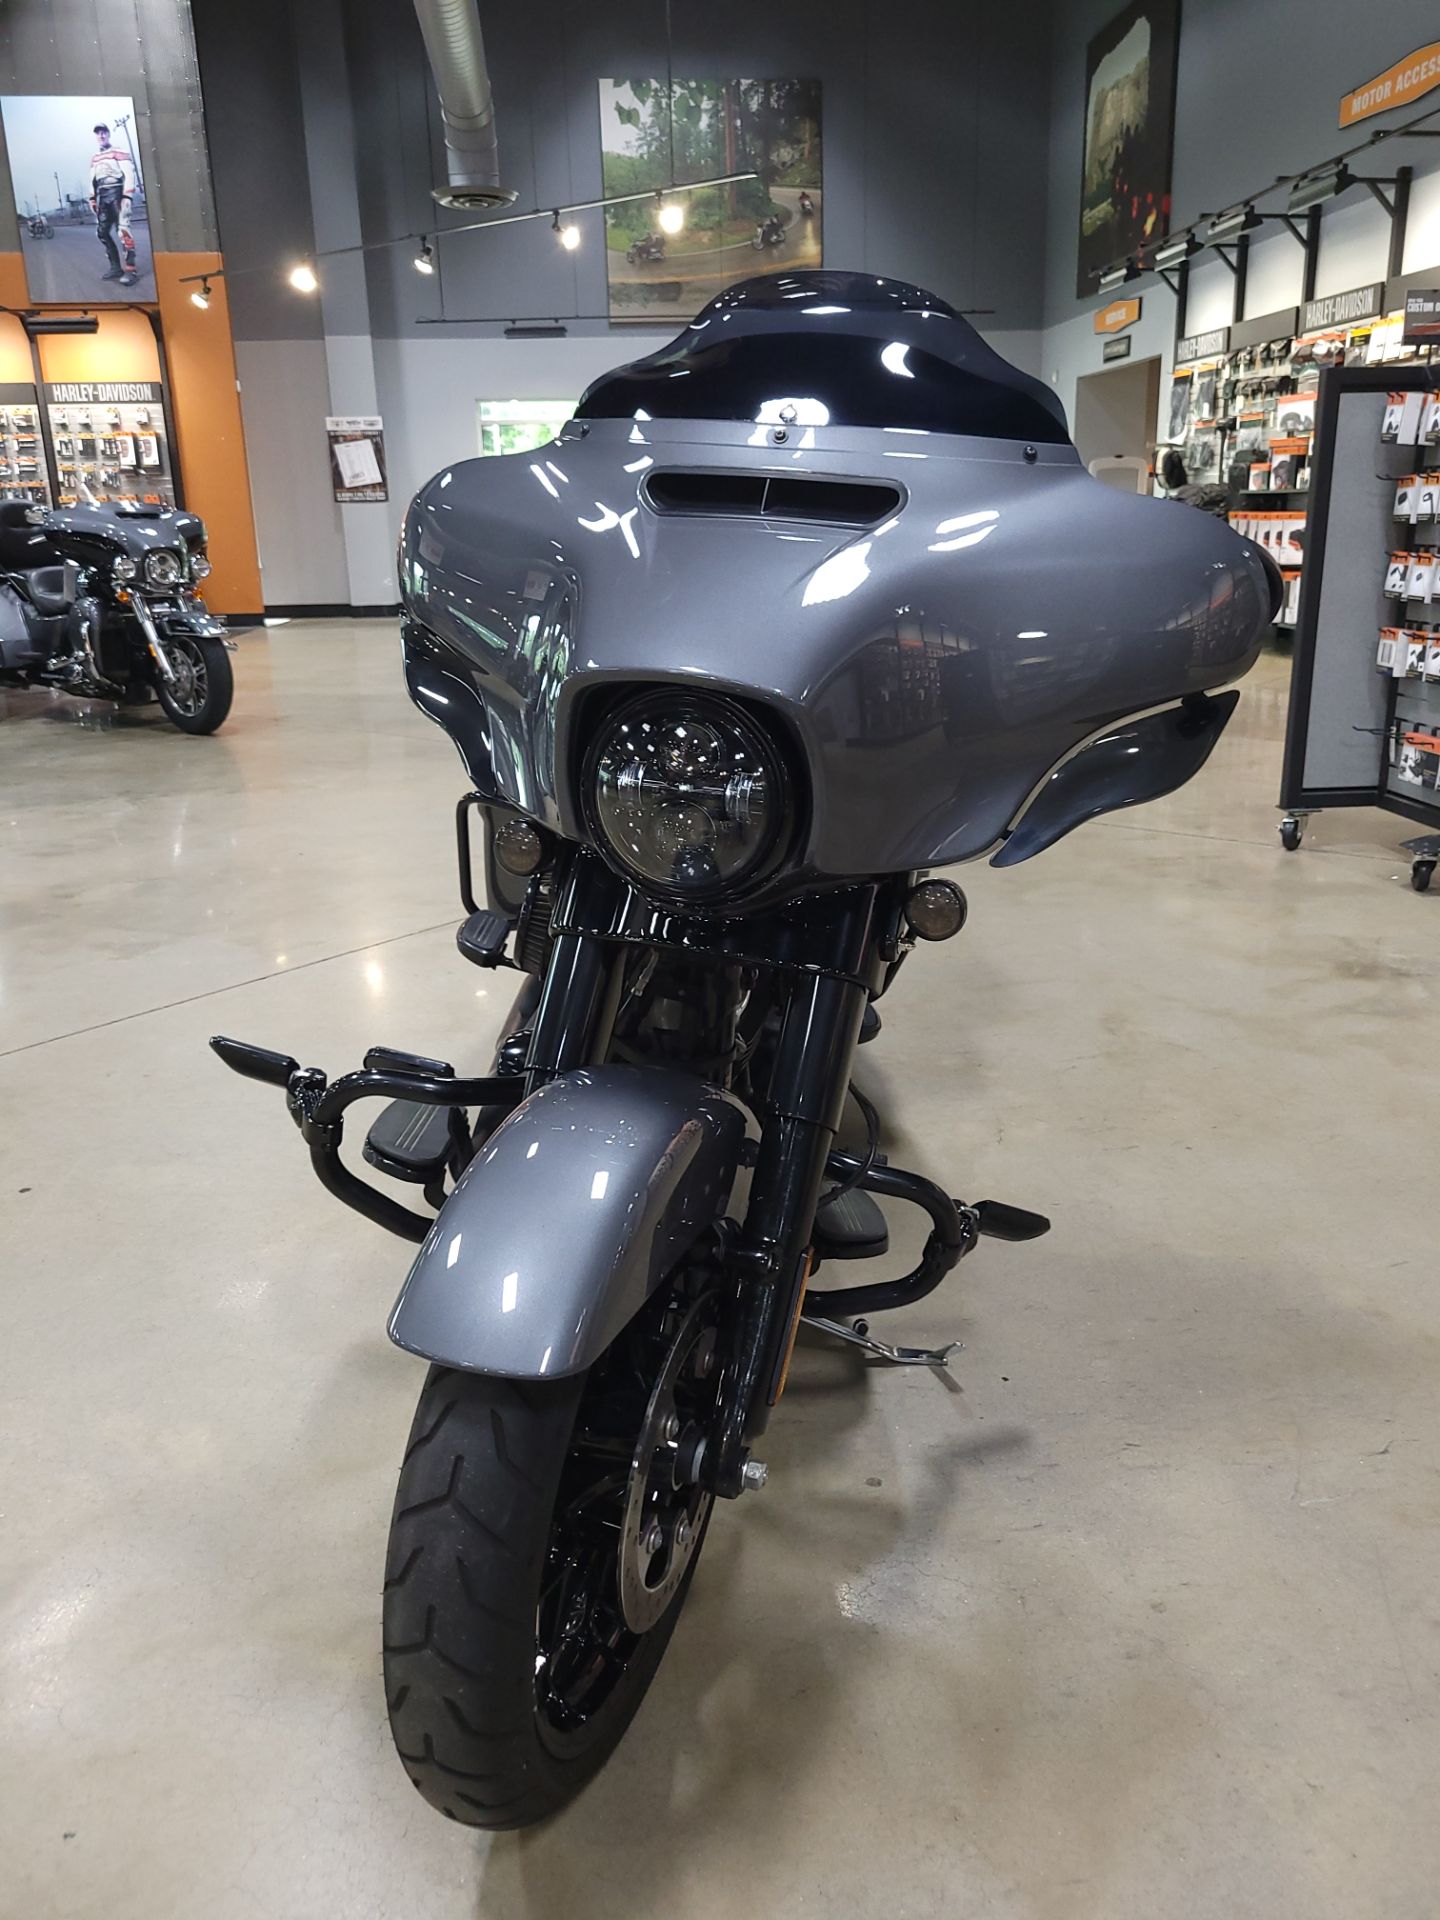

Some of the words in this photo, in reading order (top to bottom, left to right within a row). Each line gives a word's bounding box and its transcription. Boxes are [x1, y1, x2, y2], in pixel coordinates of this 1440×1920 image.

[1351, 80, 1393, 115] MOTOR
[1305, 287, 1374, 329] HARLEY-DAVIDSON
[52, 383, 152, 402] HARLEY-DAVIDSON
